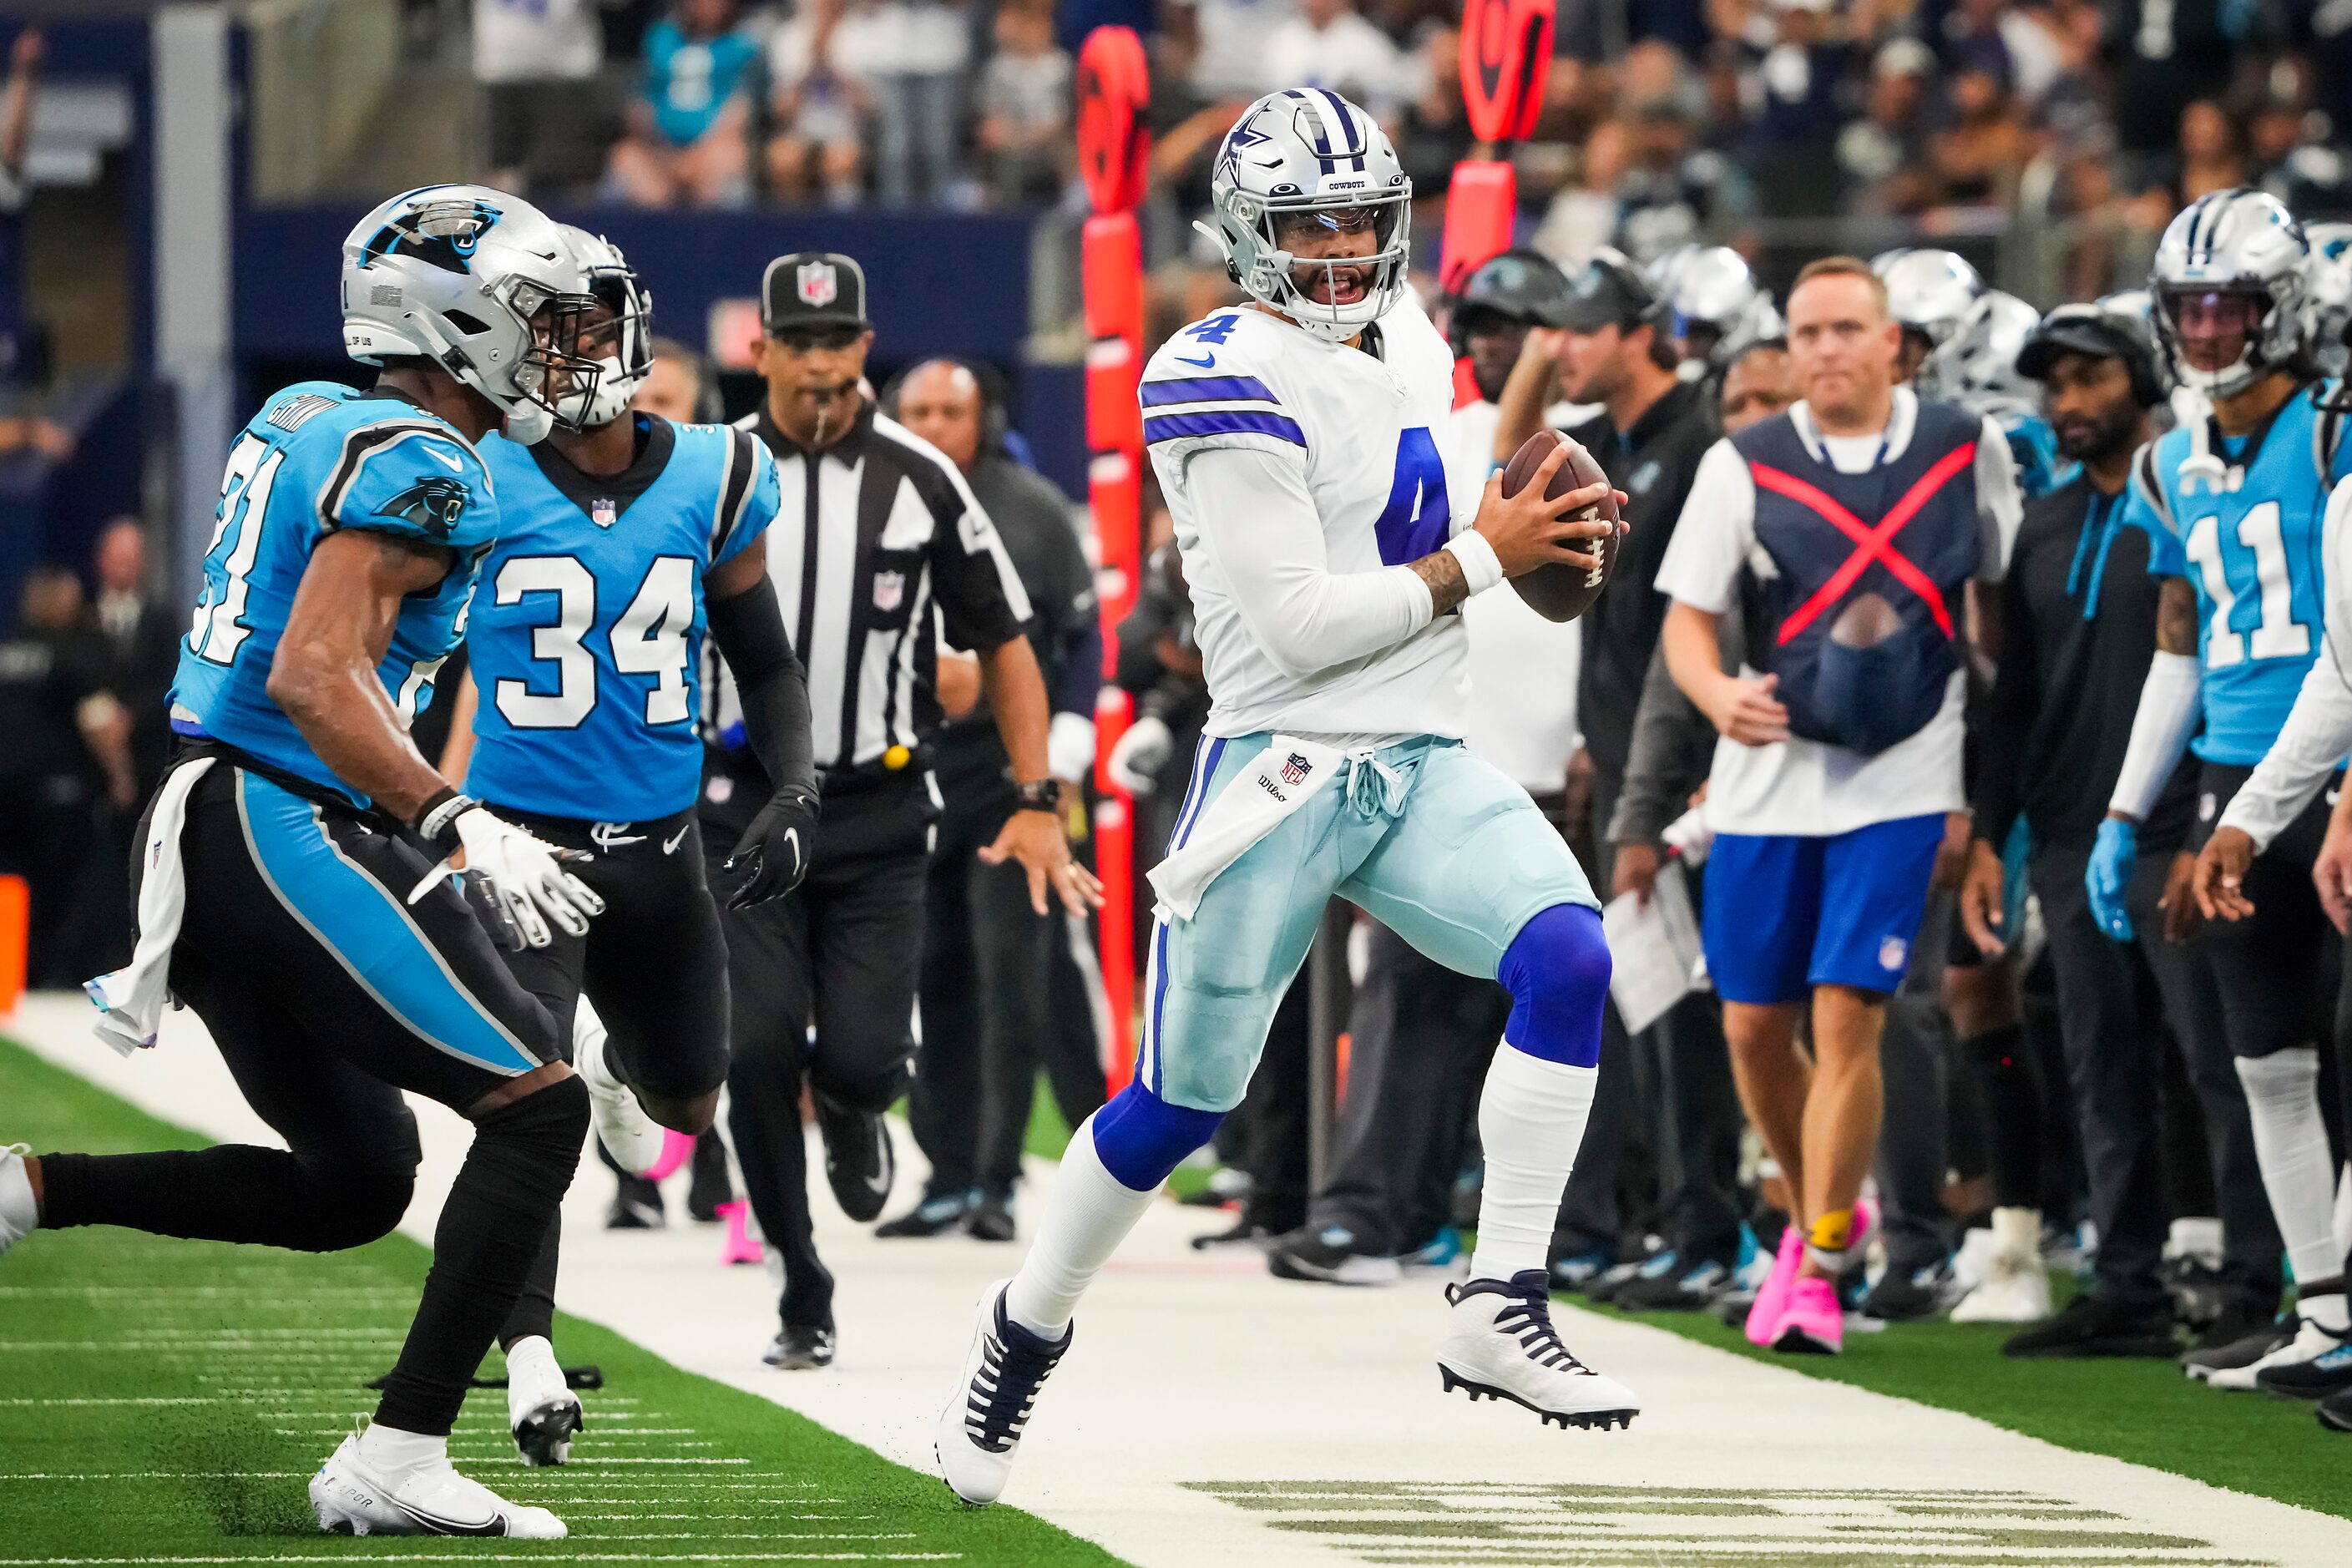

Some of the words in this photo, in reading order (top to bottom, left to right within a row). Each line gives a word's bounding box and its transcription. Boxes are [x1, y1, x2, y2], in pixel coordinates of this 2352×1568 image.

[1329, 180, 1365, 190] COWBOYS
[1185, 314, 1241, 345] 4
[188, 429, 286, 668] 21
[1373, 426, 1453, 568] 4
[494, 553, 700, 731] 34
[2185, 500, 2311, 670] 11
[1281, 761, 1303, 784] NFL
